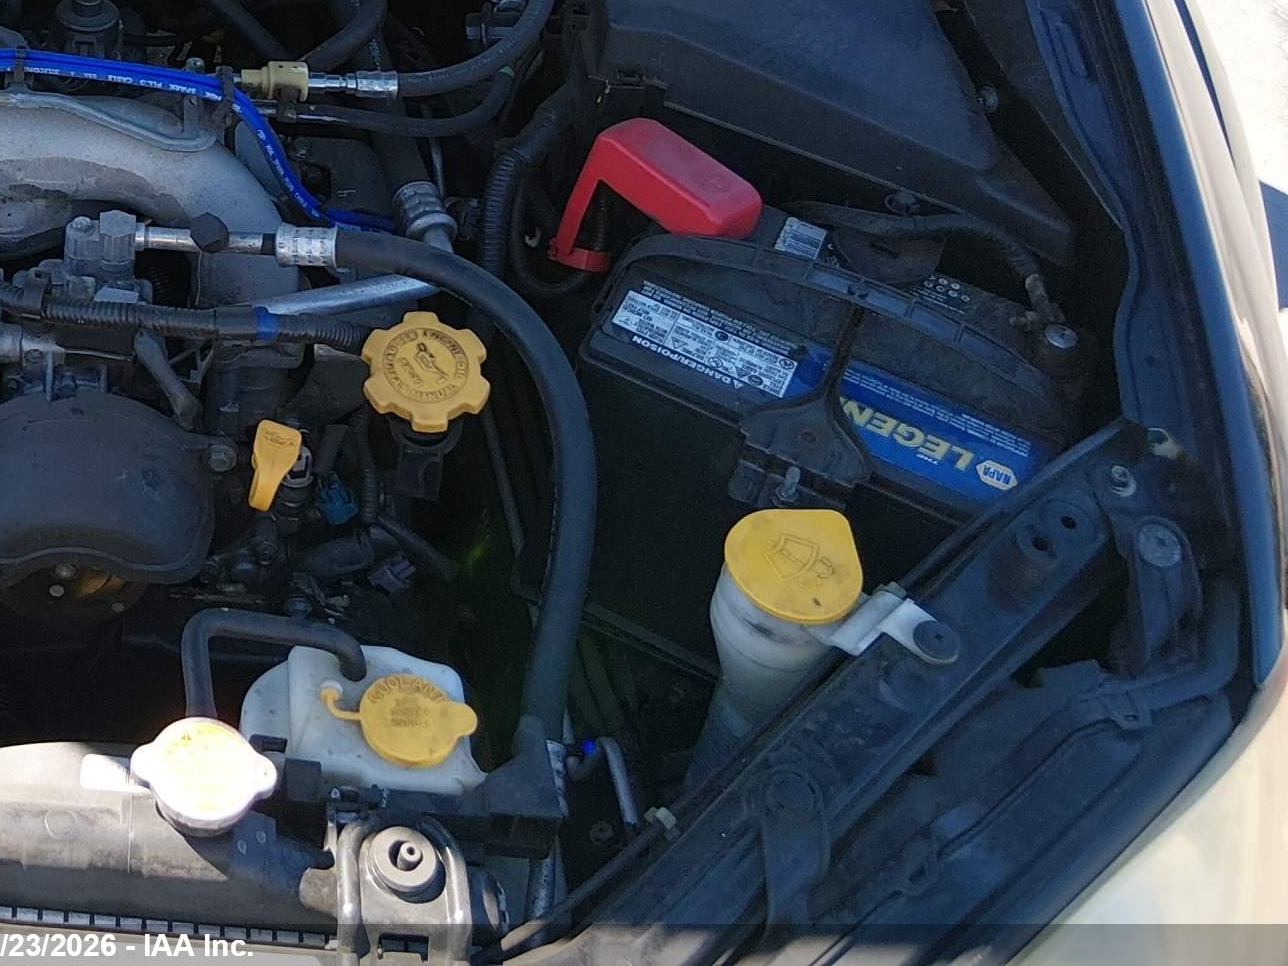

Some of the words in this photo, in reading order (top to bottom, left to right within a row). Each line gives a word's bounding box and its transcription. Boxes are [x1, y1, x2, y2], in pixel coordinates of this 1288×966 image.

[169, 83, 196, 94] SPARK
[631, 335, 732, 385] DANGER/POISON
[839, 397, 975, 471] LEGEN
[981, 464, 1012, 486] NAPA
